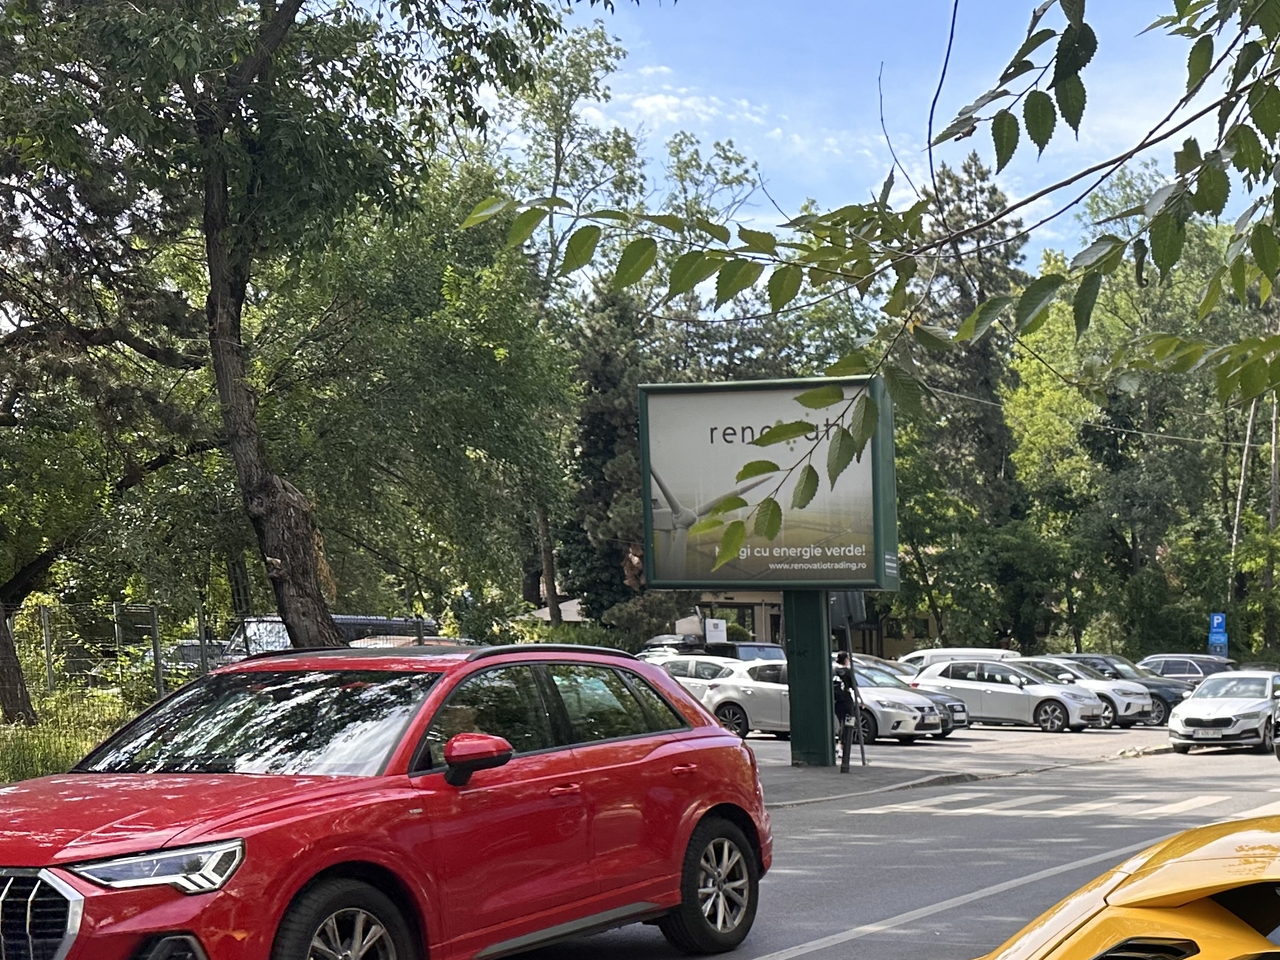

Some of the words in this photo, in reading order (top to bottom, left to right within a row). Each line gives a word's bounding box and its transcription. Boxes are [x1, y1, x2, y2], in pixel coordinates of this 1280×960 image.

[754, 546, 769, 557] cu
[772, 544, 823, 560] energie
[825, 544, 866, 557] verde!
[768, 561, 867, 571] www.renovatiotrading.ro
[1213, 615, 1223, 628] P
